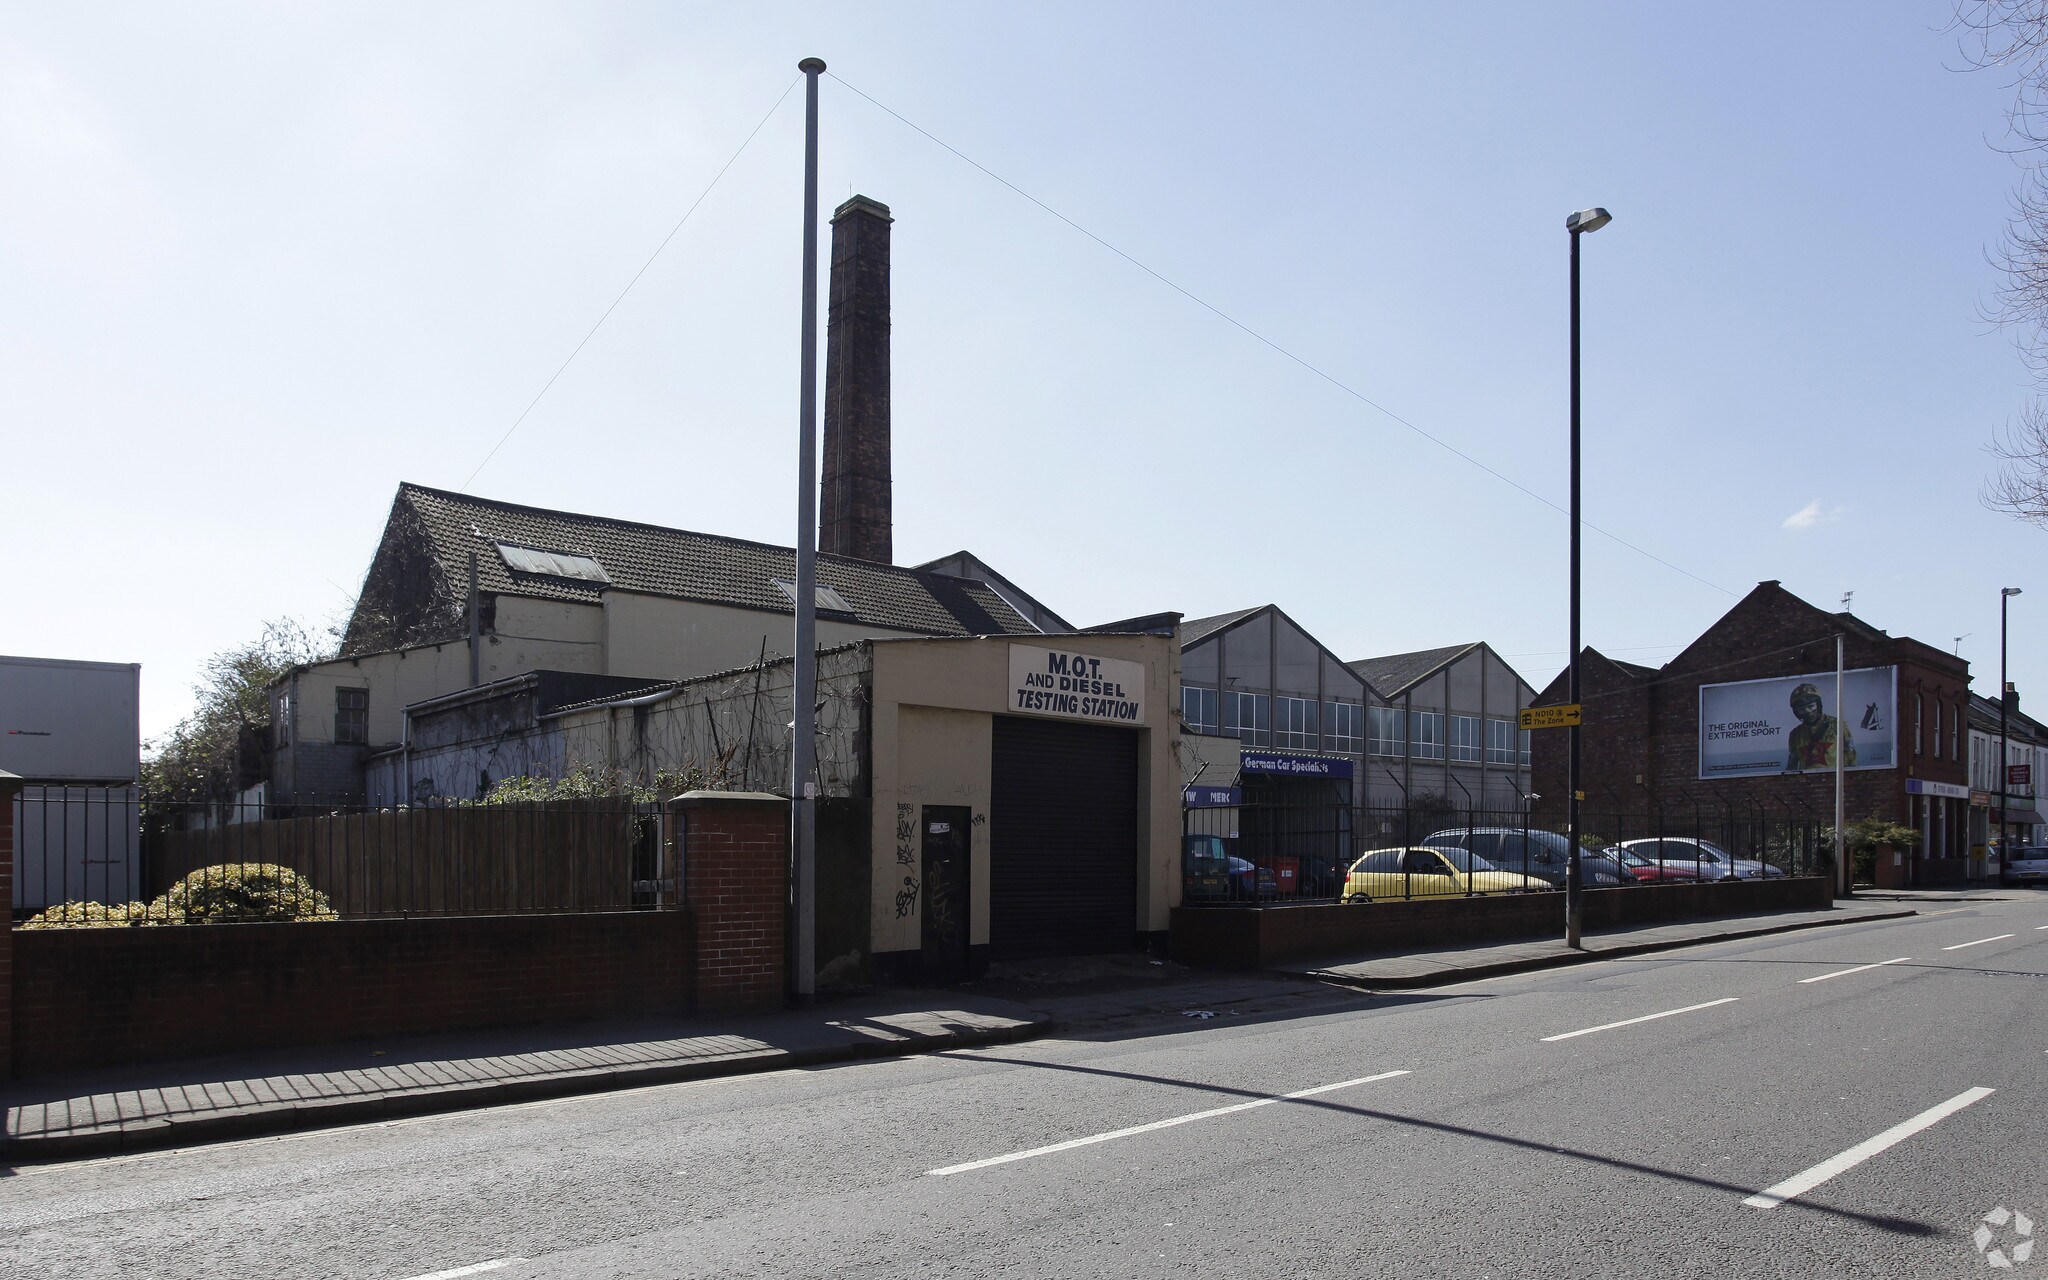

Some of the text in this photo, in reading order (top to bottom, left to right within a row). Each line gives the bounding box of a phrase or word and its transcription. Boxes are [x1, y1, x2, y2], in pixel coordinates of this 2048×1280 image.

[1049, 652, 1102, 680] M.O.T.
[1025, 672, 1126, 698] AND DIESEL
[1017, 688, 1139, 720] TESTING STATION
[1708, 720, 1769, 732] THE ORIGINAL
[1708, 727, 1781, 740] EXTREME SPORT
[1245, 756, 1276, 770] German
[1277, 758, 1291, 770] Car
